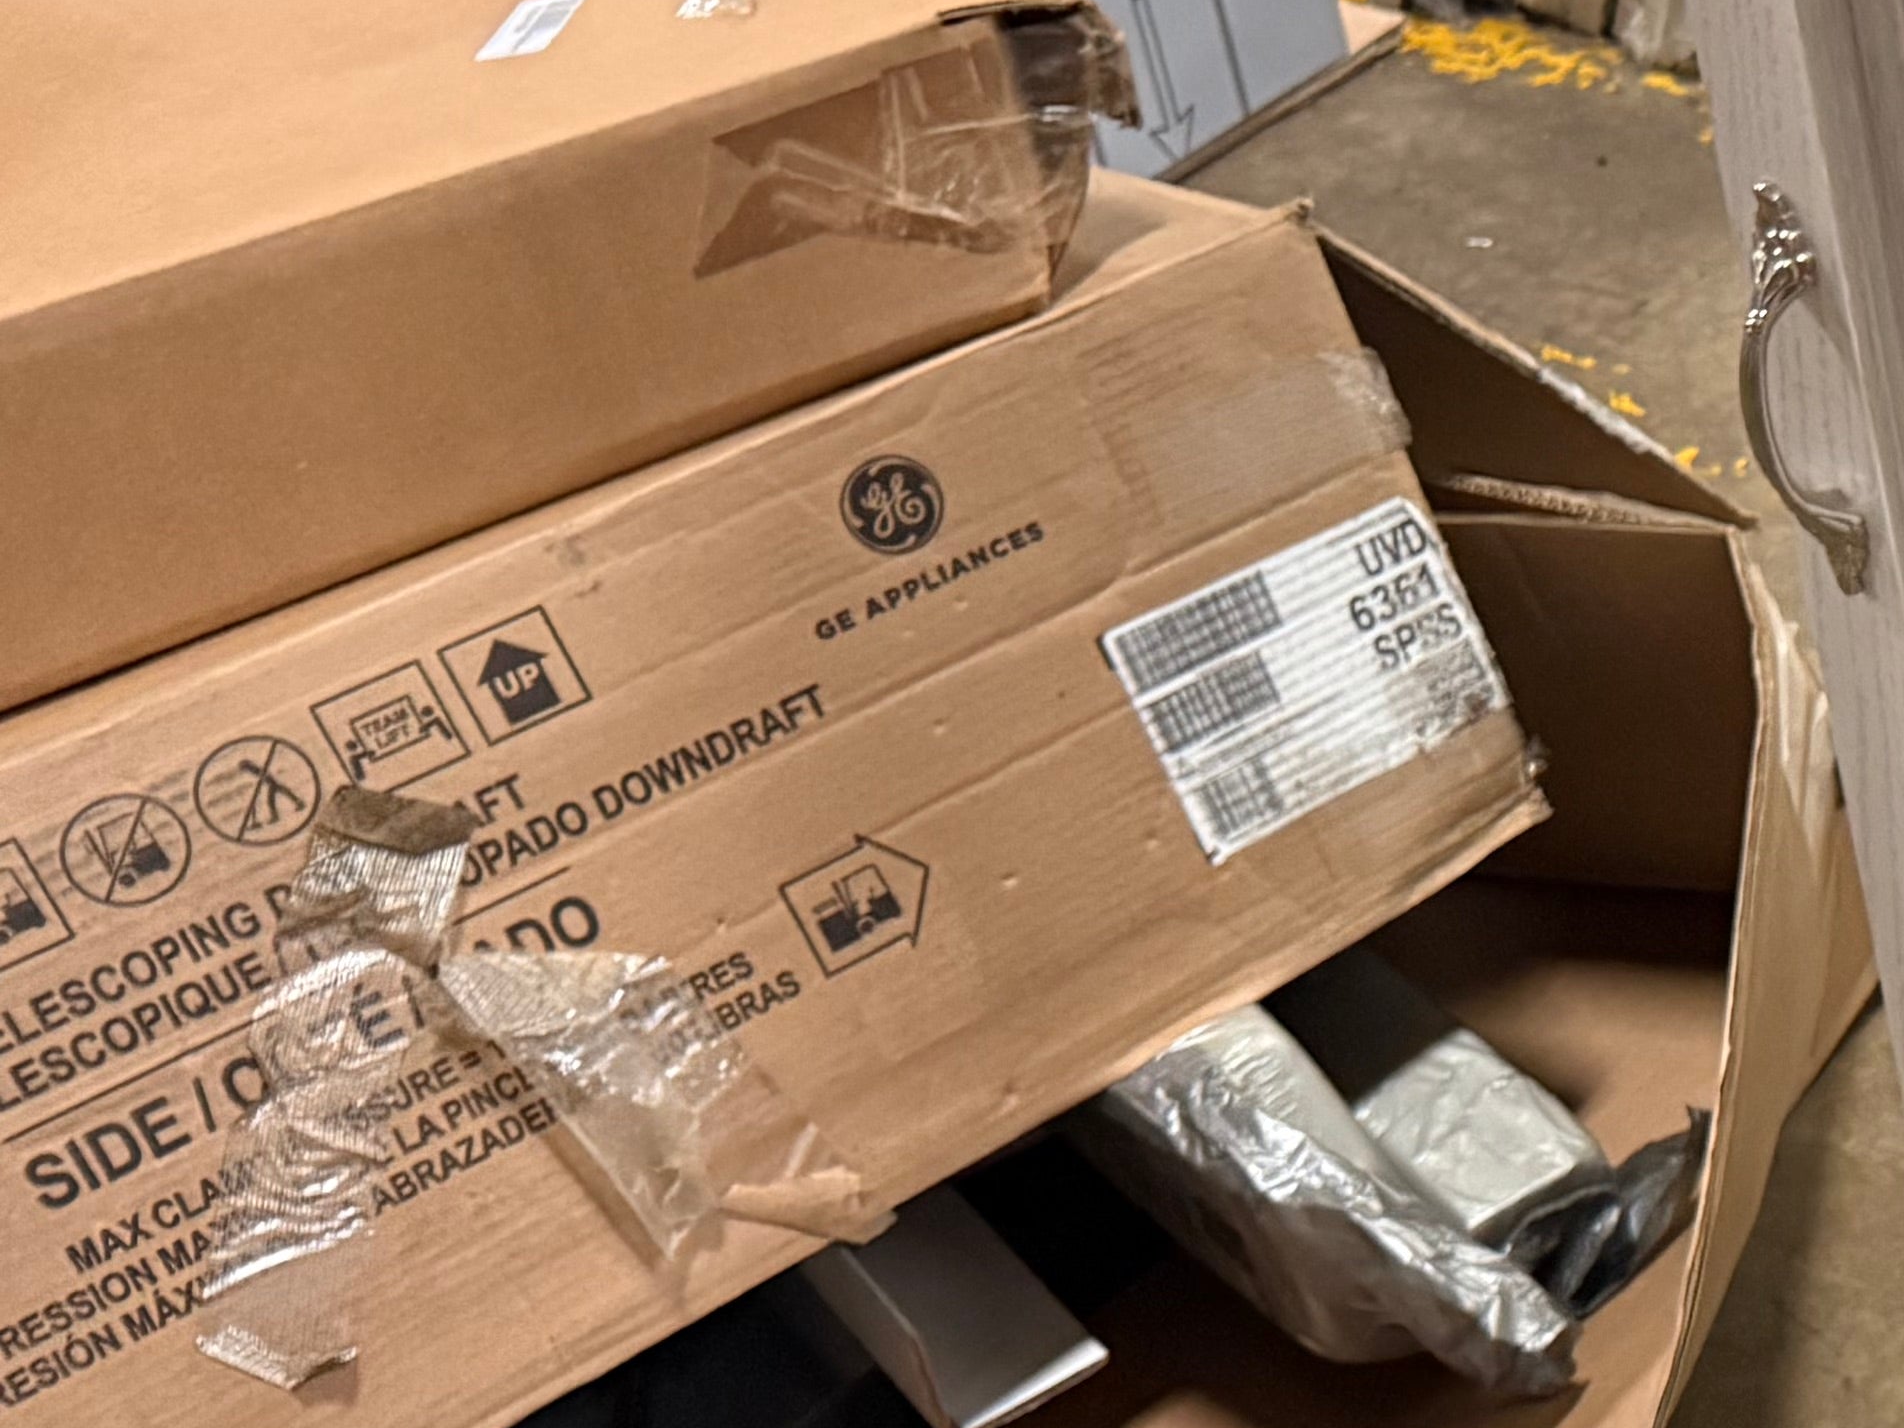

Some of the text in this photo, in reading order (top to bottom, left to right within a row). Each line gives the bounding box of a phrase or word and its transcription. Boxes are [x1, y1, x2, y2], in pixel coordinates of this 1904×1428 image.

[1355, 519, 1427, 576] UVD
[814, 521, 1044, 640] GE APPLIANCES
[493, 662, 539, 699] UP
[361, 708, 409, 736] TEAM
[375, 723, 411, 749] LIFT
[592, 683, 827, 821] DOWNDRAFT
[25, 1096, 193, 1209] SIDE
[192, 1076, 218, 1133] /
[392, 1113, 446, 1155] LA
[65, 1213, 154, 1274] MAX
